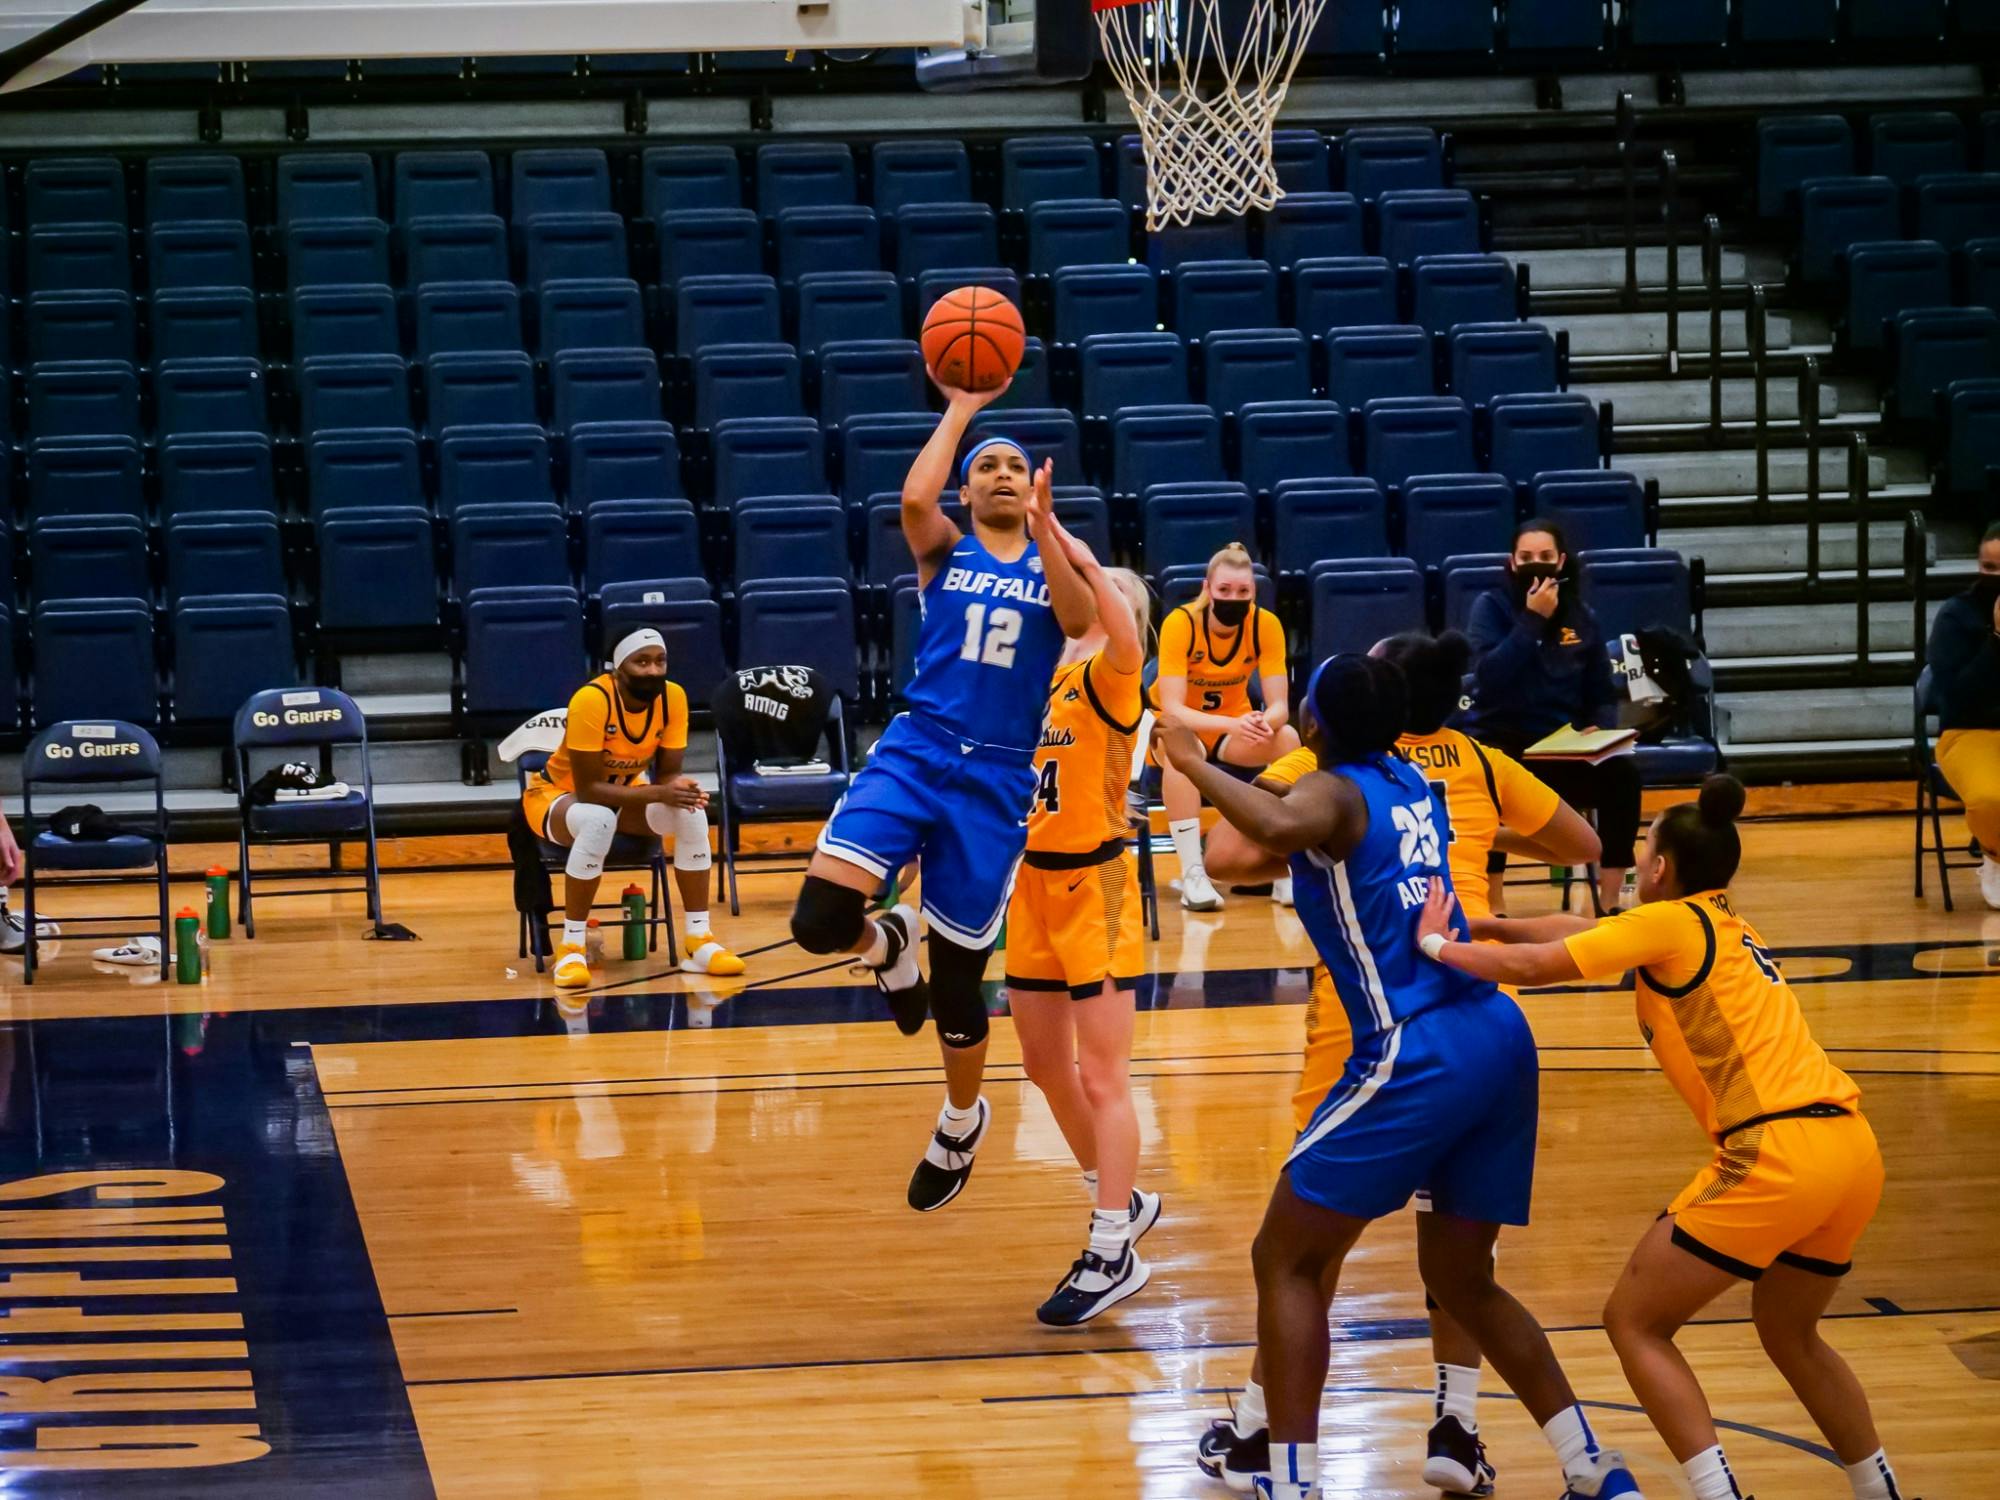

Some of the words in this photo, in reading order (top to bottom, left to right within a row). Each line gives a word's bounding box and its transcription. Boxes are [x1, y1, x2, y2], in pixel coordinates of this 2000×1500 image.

[942, 567, 1051, 607] BUFFALO
[960, 602, 1023, 669] 12
[1202, 691, 1222, 711] 5
[252, 711, 279, 727] Go
[284, 709, 342, 725] GRIFFS
[45, 743, 73, 759] Go
[79, 742, 140, 758] GRIFFS
[1391, 795, 1441, 869] 25
